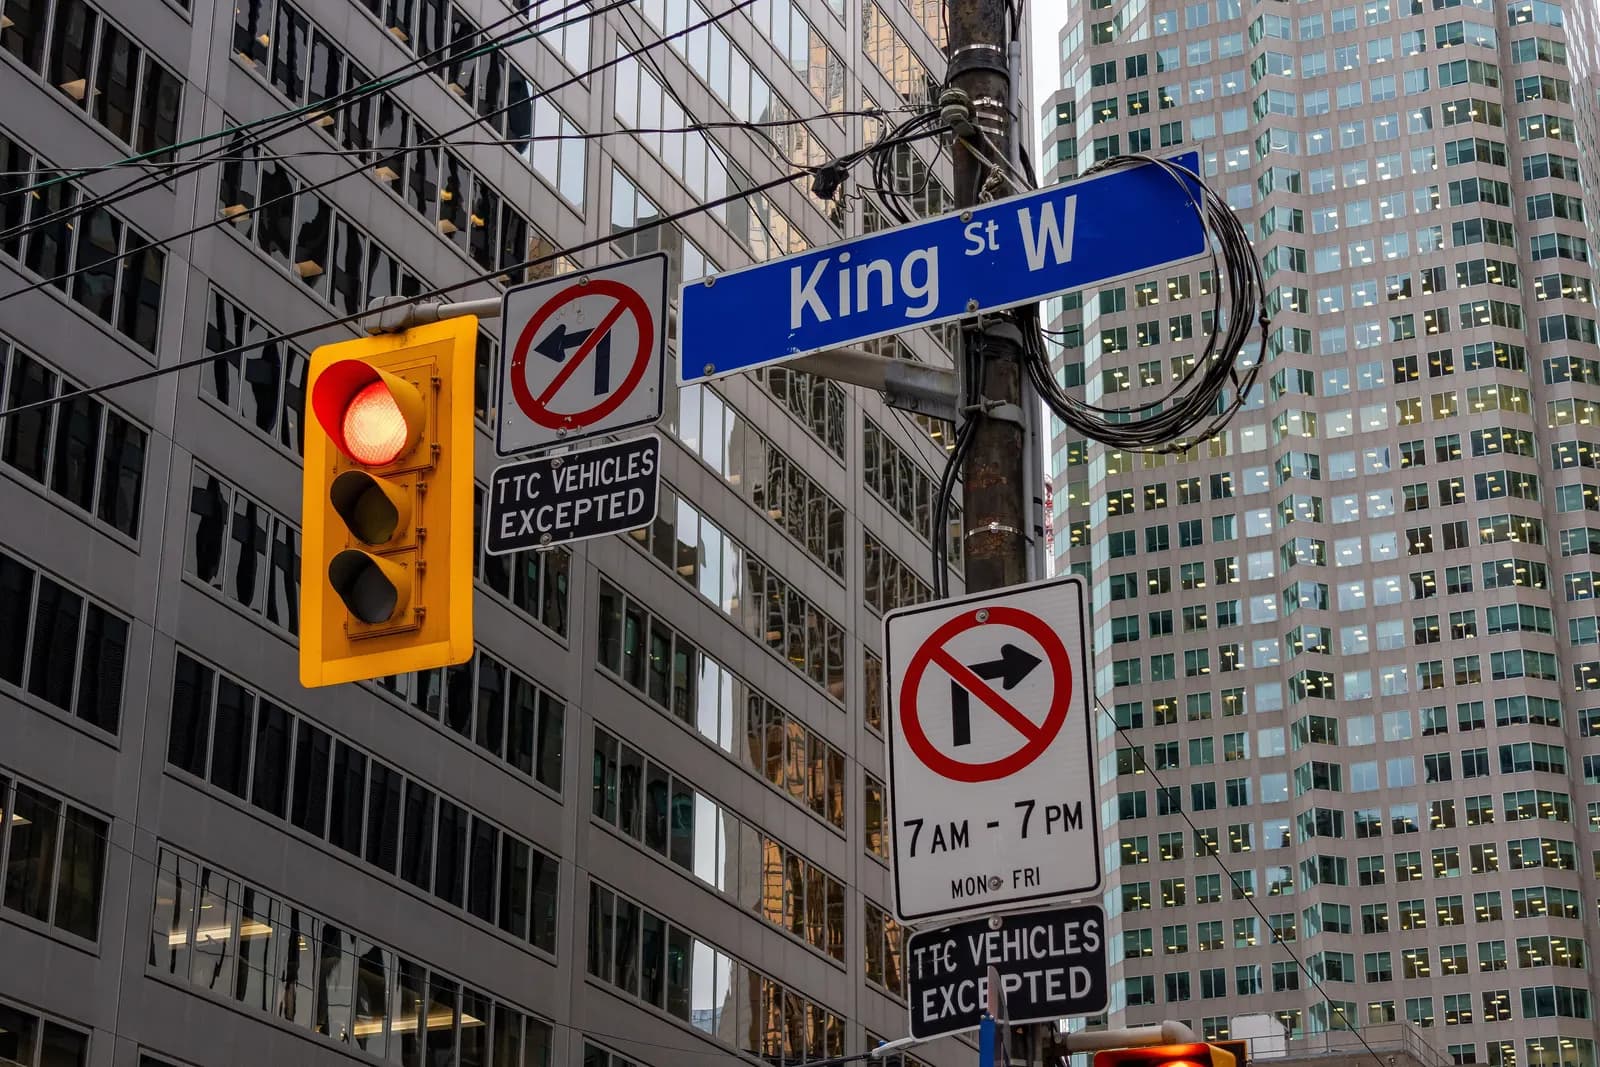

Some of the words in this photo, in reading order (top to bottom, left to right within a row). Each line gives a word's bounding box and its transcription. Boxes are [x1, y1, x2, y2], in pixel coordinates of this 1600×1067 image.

[790, 245, 939, 330] King
[964, 219, 999, 257] St
[1018, 194, 1078, 272] W
[497, 472, 541, 505] TTC
[552, 449, 655, 495] VEHICLES
[501, 487, 646, 540] EXCEPTED
[951, 875, 988, 899] MON
[1013, 867, 1041, 889] FRI
[914, 939, 958, 980] TTC
[968, 919, 1101, 967] VEHICLES
[922, 966, 1092, 1023] EXCEPTED
